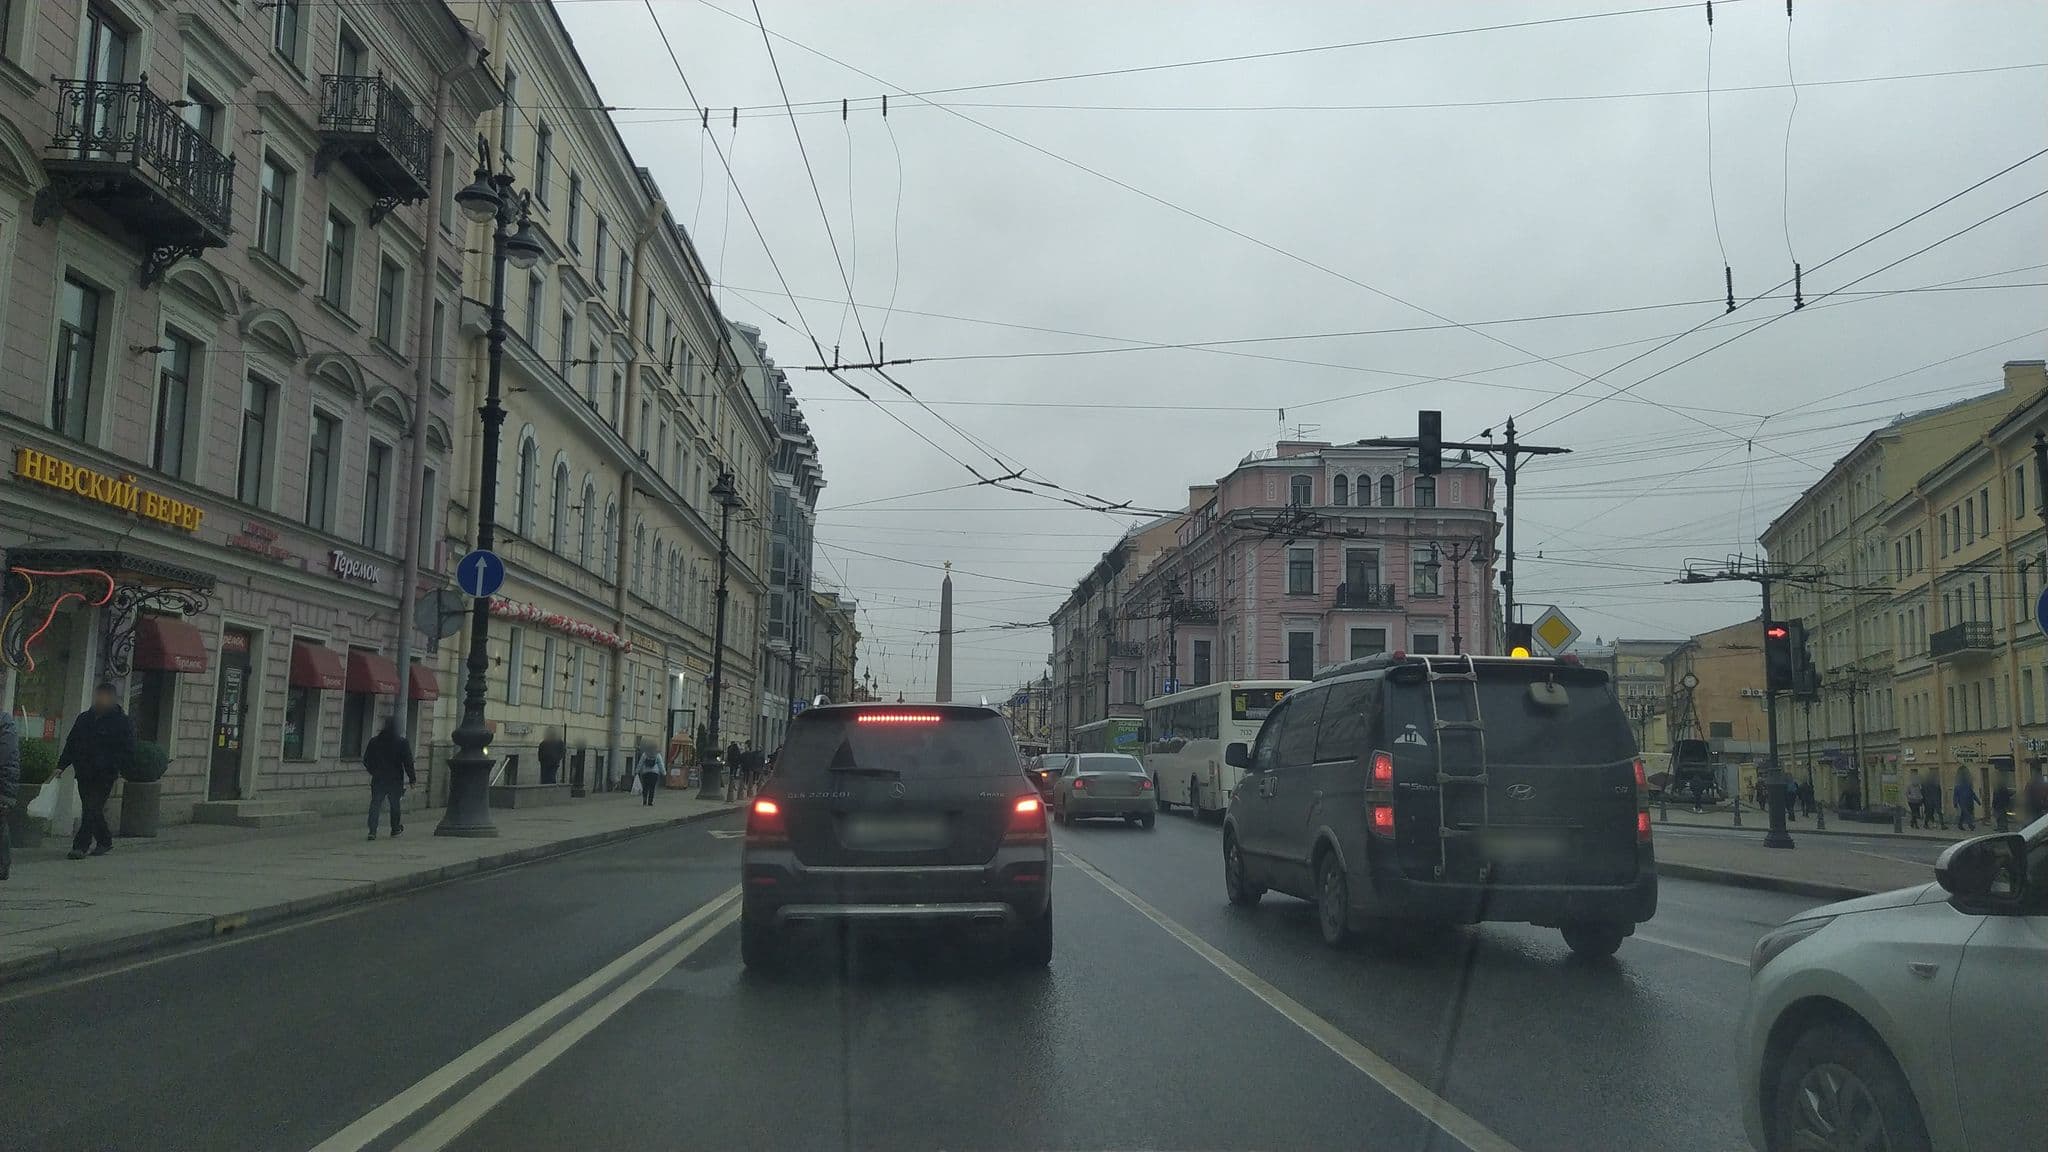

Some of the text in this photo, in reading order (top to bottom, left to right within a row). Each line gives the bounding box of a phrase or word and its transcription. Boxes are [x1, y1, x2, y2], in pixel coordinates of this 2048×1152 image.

[23, 447, 140, 513] НЕВСКИЙ
[144, 489, 206, 532] БЕРЕГ
[333, 550, 381, 584] Теремок
